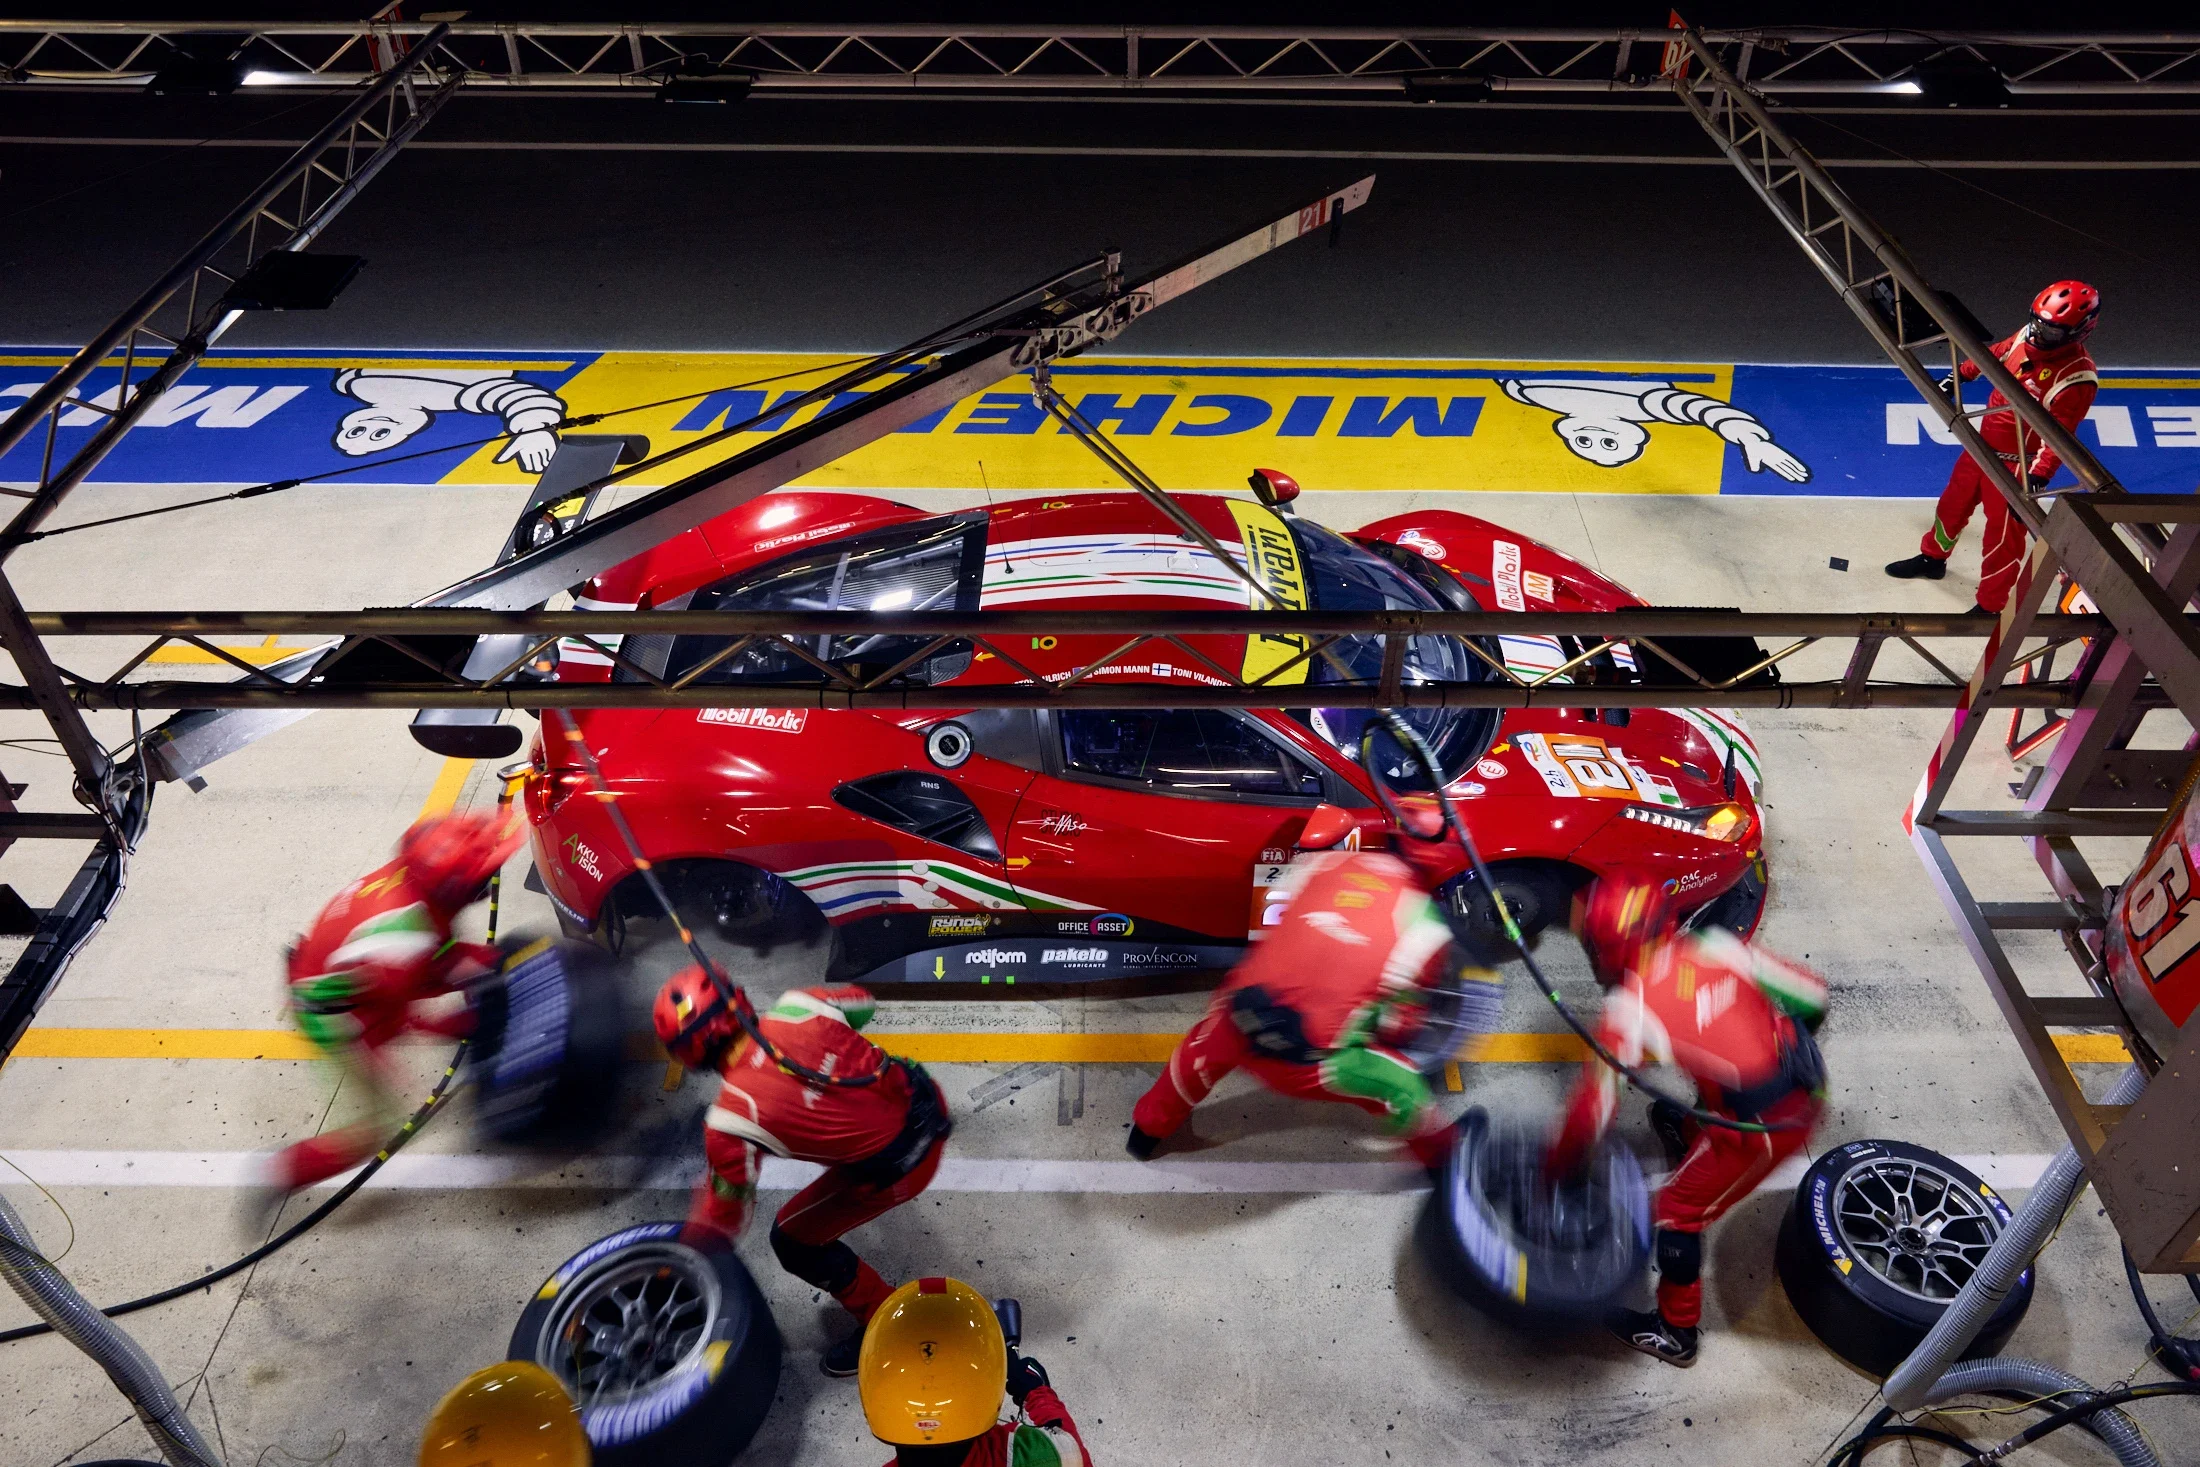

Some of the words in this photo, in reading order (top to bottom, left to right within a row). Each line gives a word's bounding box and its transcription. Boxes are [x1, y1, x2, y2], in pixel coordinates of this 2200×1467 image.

[1301, 202, 1322, 232] 21
[1498, 544, 1520, 583] Plastic
[1527, 574, 1550, 598] AM
[1094, 666, 1122, 675] SIMON
[1123, 665, 1150, 674] MANN
[1172, 667, 1193, 679] TONI
[1193, 672, 1233, 687] VILAND
[749, 708, 803, 730] Plastic
[1551, 742, 1633, 791] 21
[920, 781, 940, 790] RNS
[562, 833, 599, 864] AKKU
[571, 852, 604, 882] VISION
[1679, 872, 1718, 894] Analytics
[932, 918, 975, 928] RYNO
[2129, 842, 2200, 982] 61
[931, 926, 984, 934] POWER
[1058, 922, 1089, 931] OFFICE
[1097, 922, 1127, 932] ASSET
[965, 948, 1027, 969] rotiform
[1040, 947, 1109, 965] pakelo
[1813, 1178, 1836, 1246] MICHELIN
